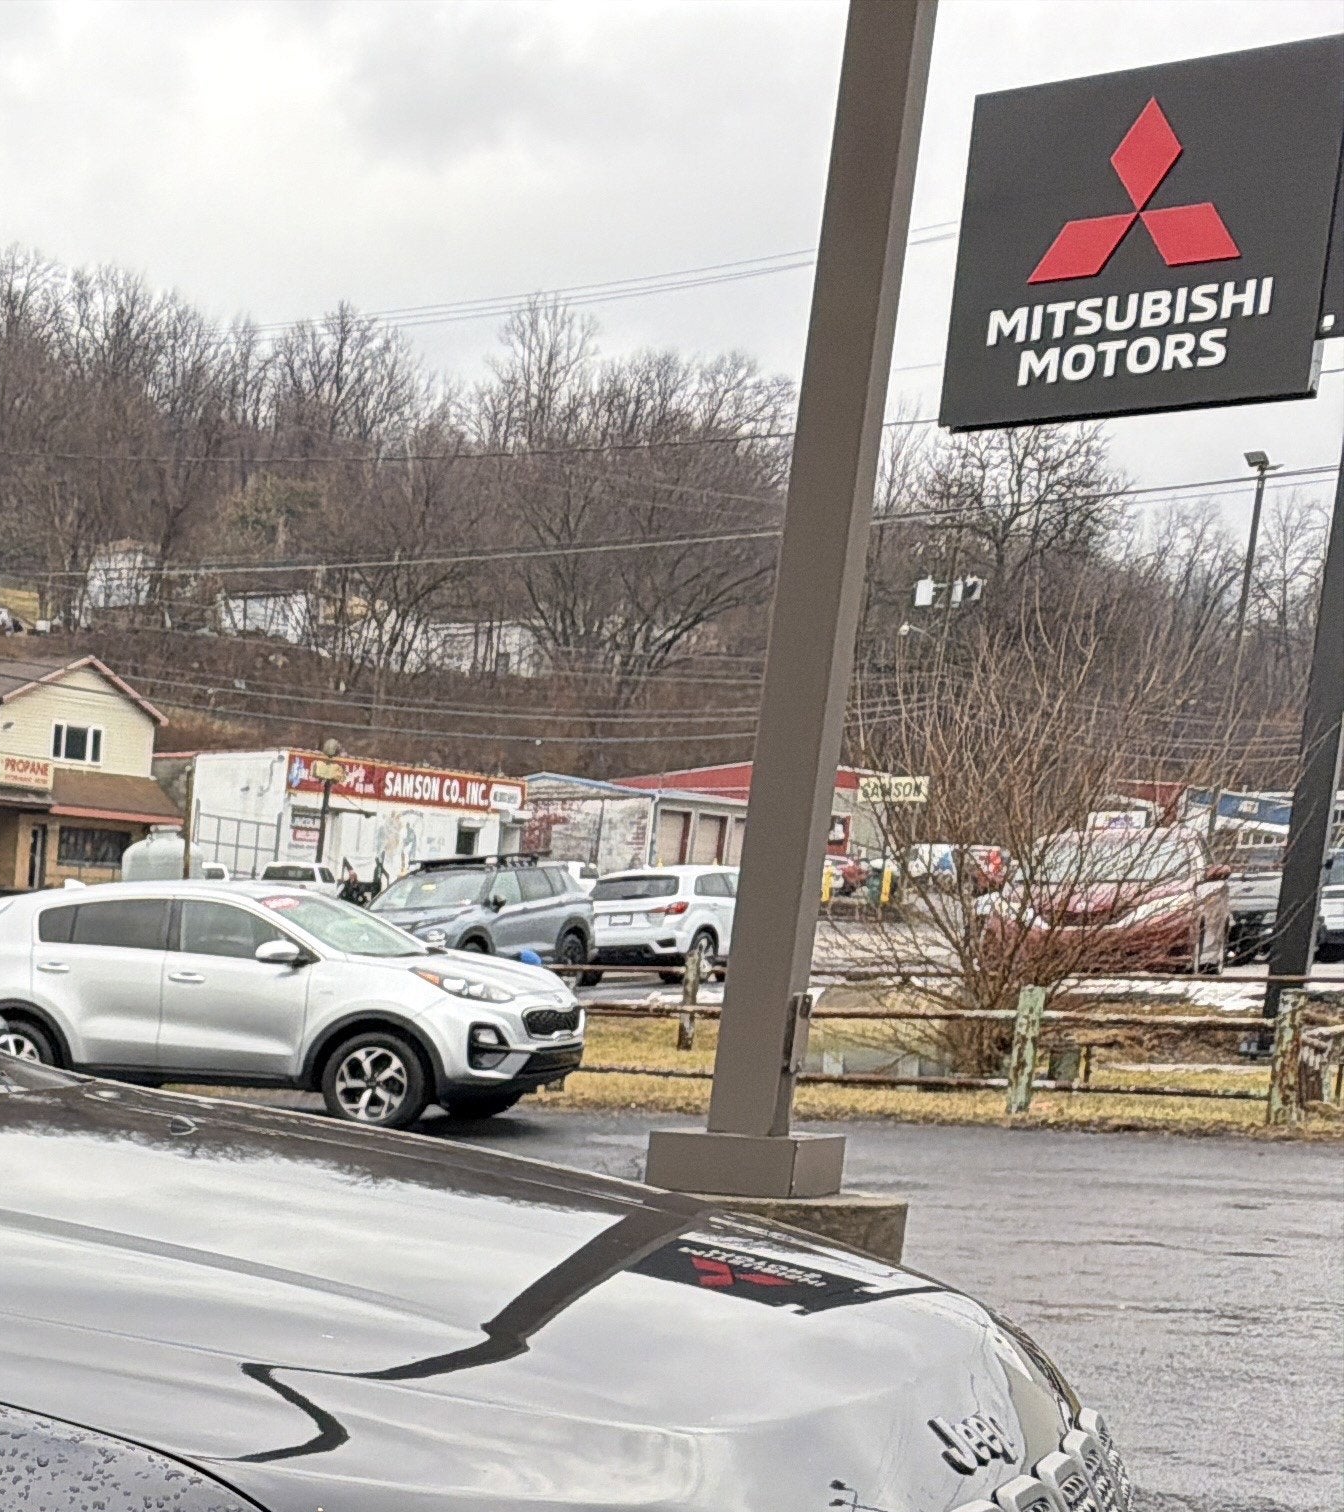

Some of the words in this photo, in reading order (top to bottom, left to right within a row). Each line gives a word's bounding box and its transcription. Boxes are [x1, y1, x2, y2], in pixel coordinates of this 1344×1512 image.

[986, 277, 1273, 346] MITSUBISHI
[1017, 329, 1228, 387] MOTORS
[4, 757, 50, 777] PROPANE
[384, 771, 439, 801] SAMSON
[928, 1413, 1017, 1475] Jeep
